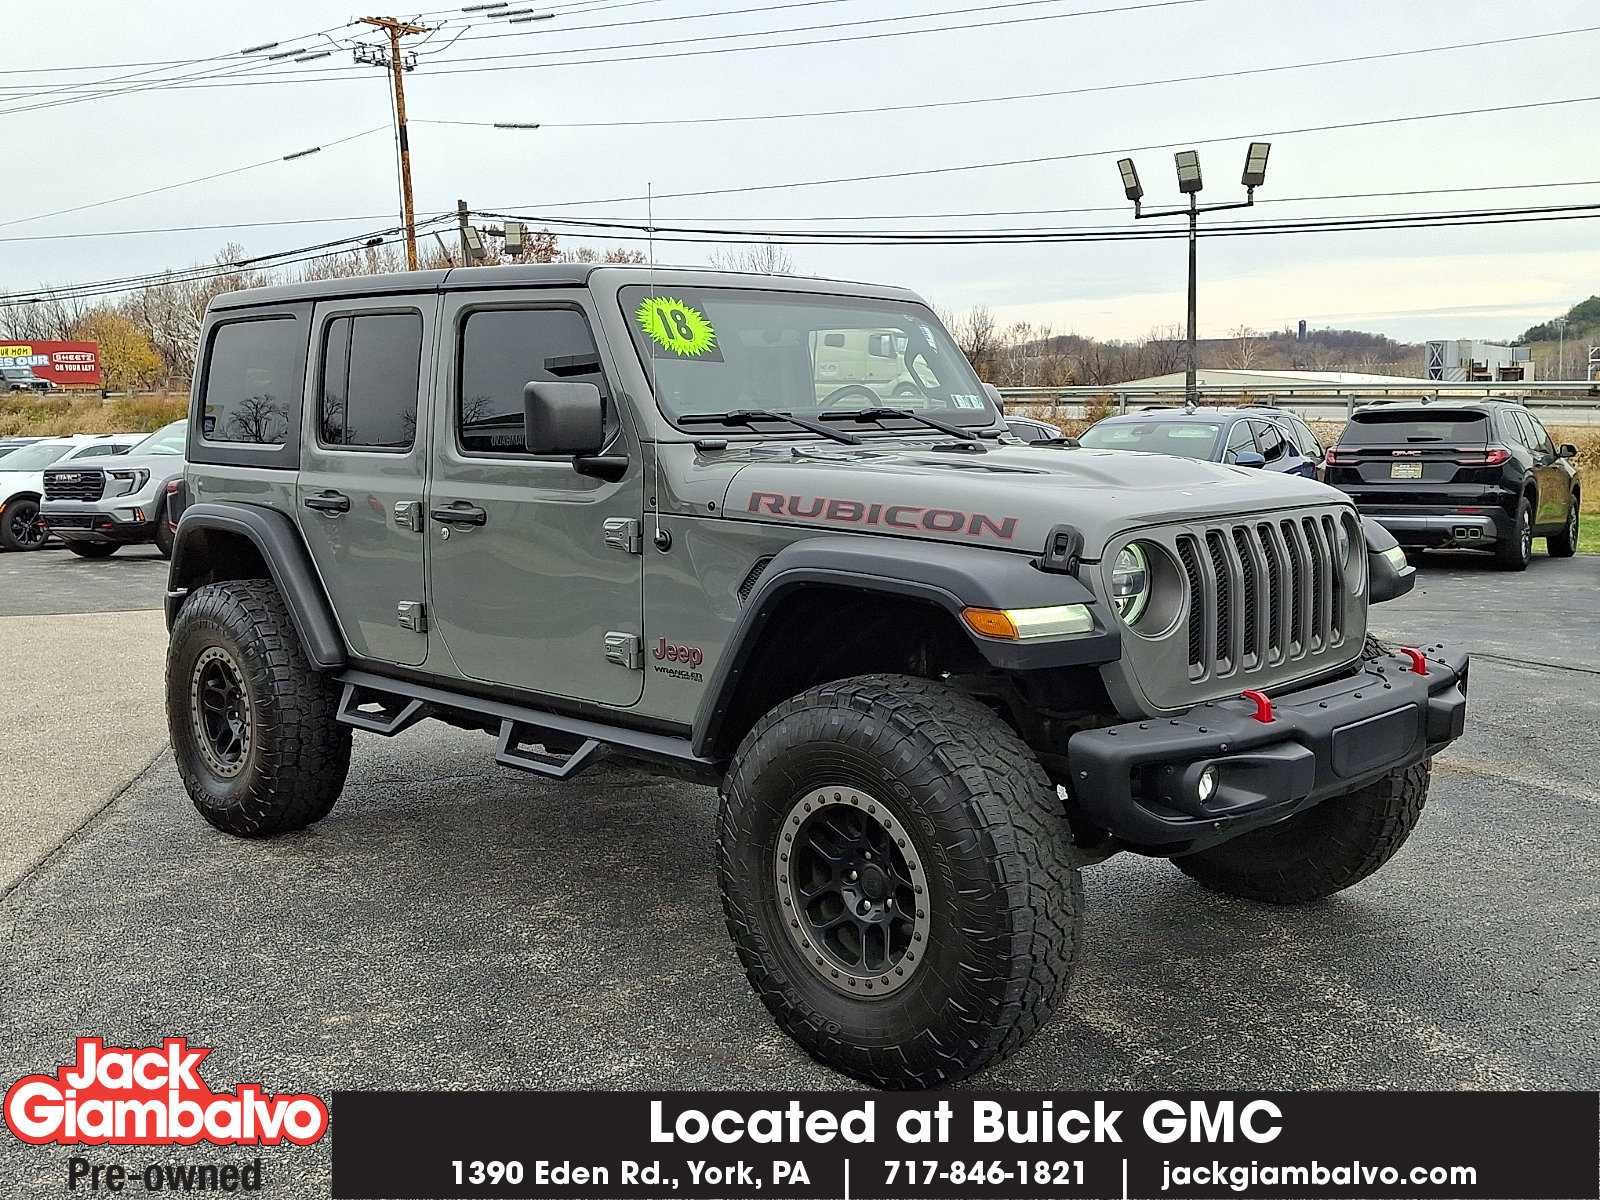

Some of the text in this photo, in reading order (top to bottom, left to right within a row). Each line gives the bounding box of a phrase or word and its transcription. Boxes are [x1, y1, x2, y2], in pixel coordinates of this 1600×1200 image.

[656, 308, 694, 340] 18
[11, 348, 28, 356] MOM
[15, 355, 50, 366] OUR
[82, 364, 95, 372] LEFT
[747, 491, 1020, 541] RUBICON
[652, 636, 703, 669] Jeep
[653, 665, 703, 679] WRANGLER
